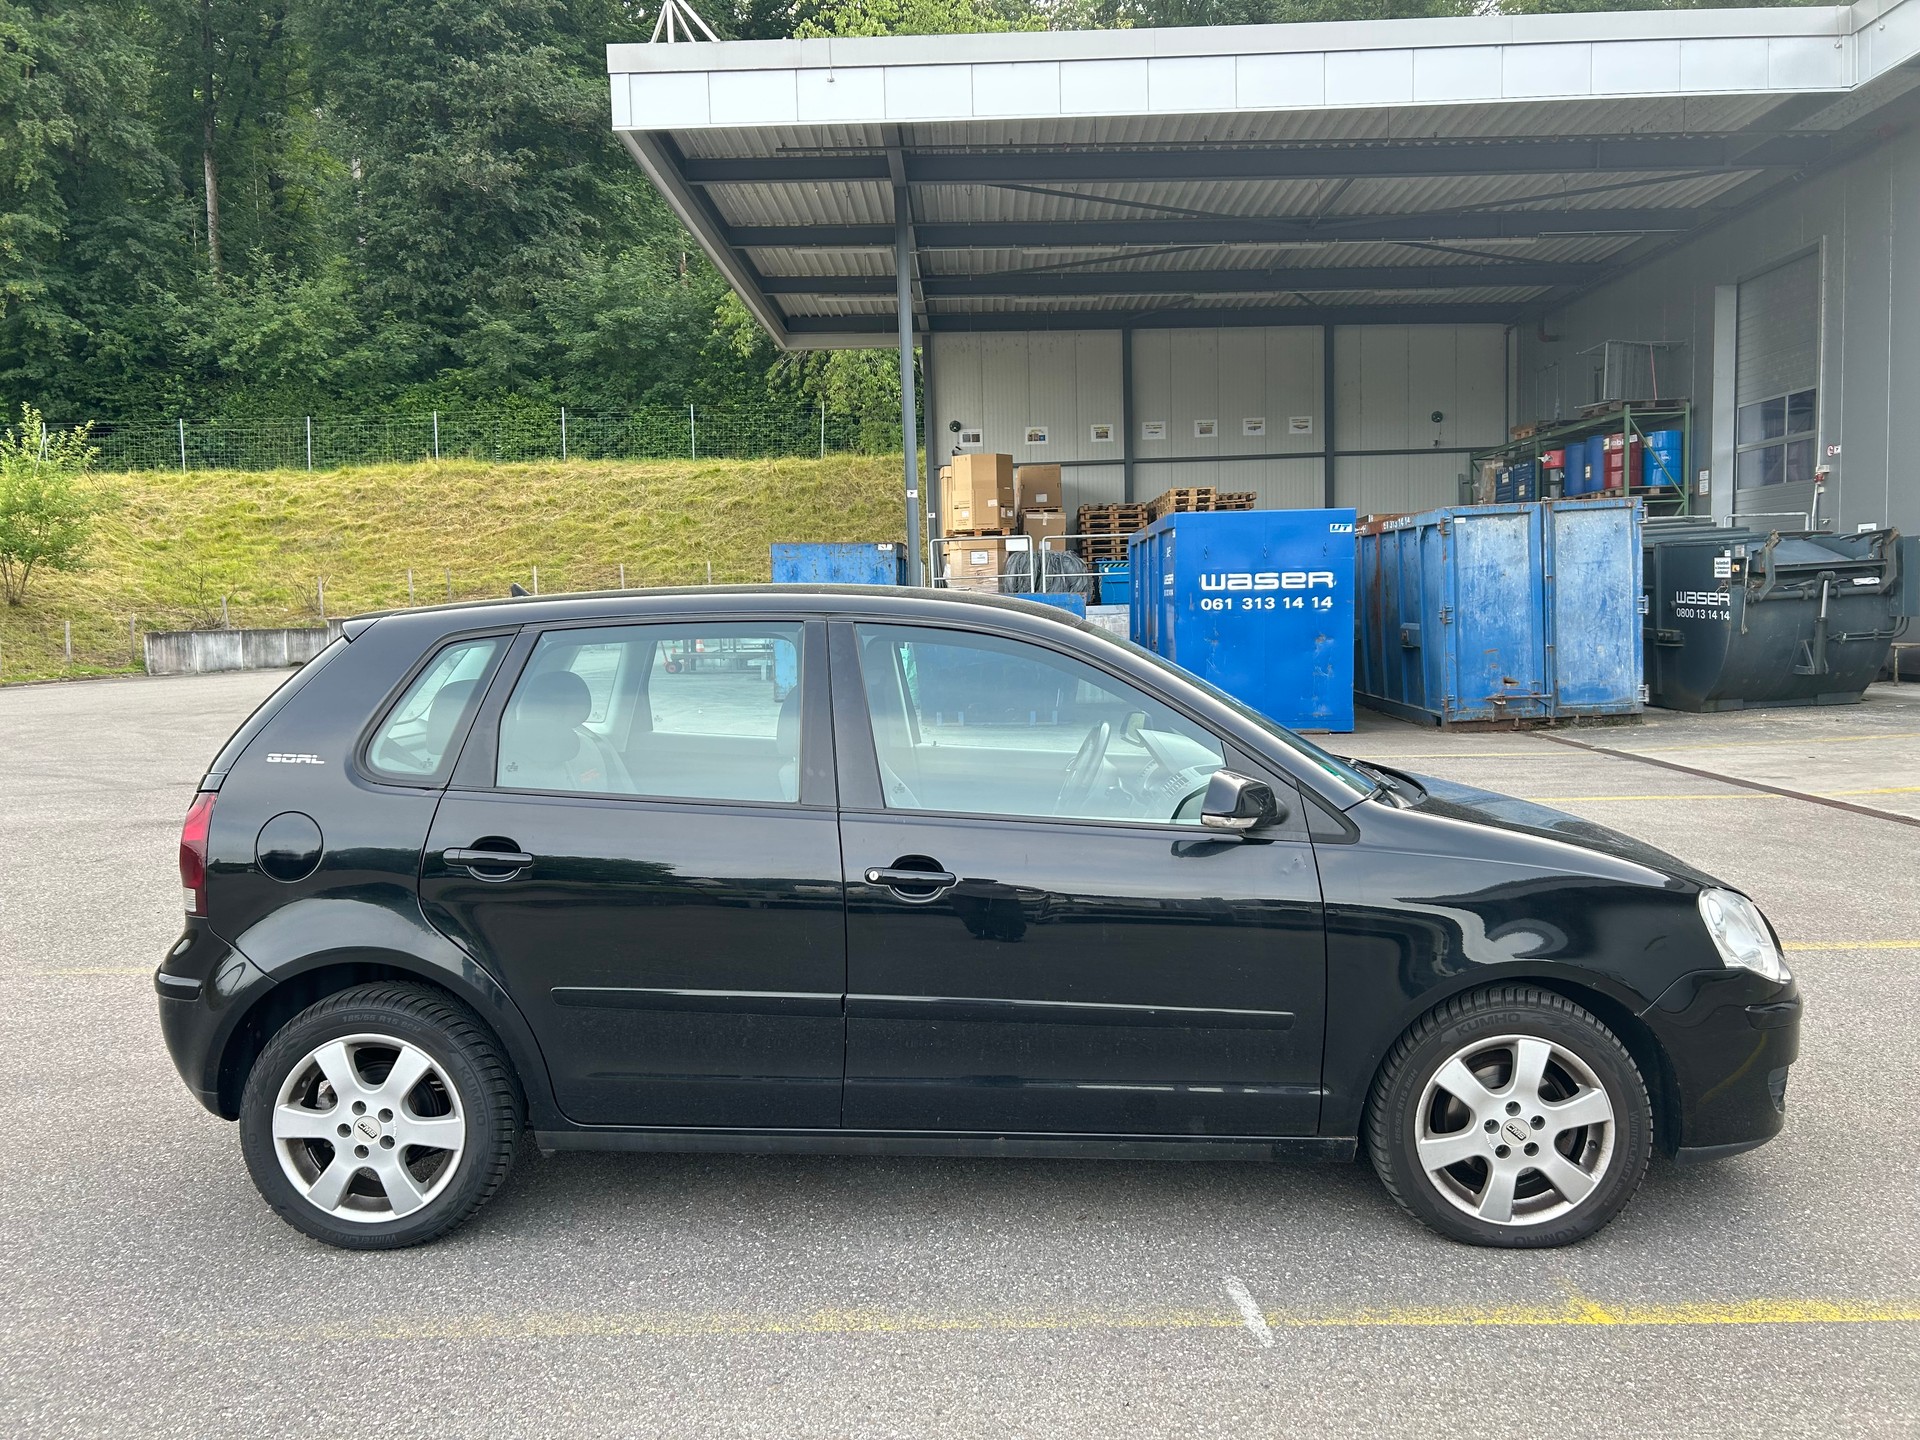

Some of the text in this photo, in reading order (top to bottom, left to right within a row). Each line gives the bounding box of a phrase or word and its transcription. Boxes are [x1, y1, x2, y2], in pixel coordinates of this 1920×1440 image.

[1200, 596, 1333, 610] 061 313 14 14
[1676, 608, 1730, 620] 0800 13 14 14
[266, 753, 325, 764] GOAL
[1455, 1013, 1520, 1036] KUMHO
[458, 1066, 486, 1126] KUMHO
[358, 1121, 377, 1139] CMS
[1506, 1123, 1526, 1141] CMS
